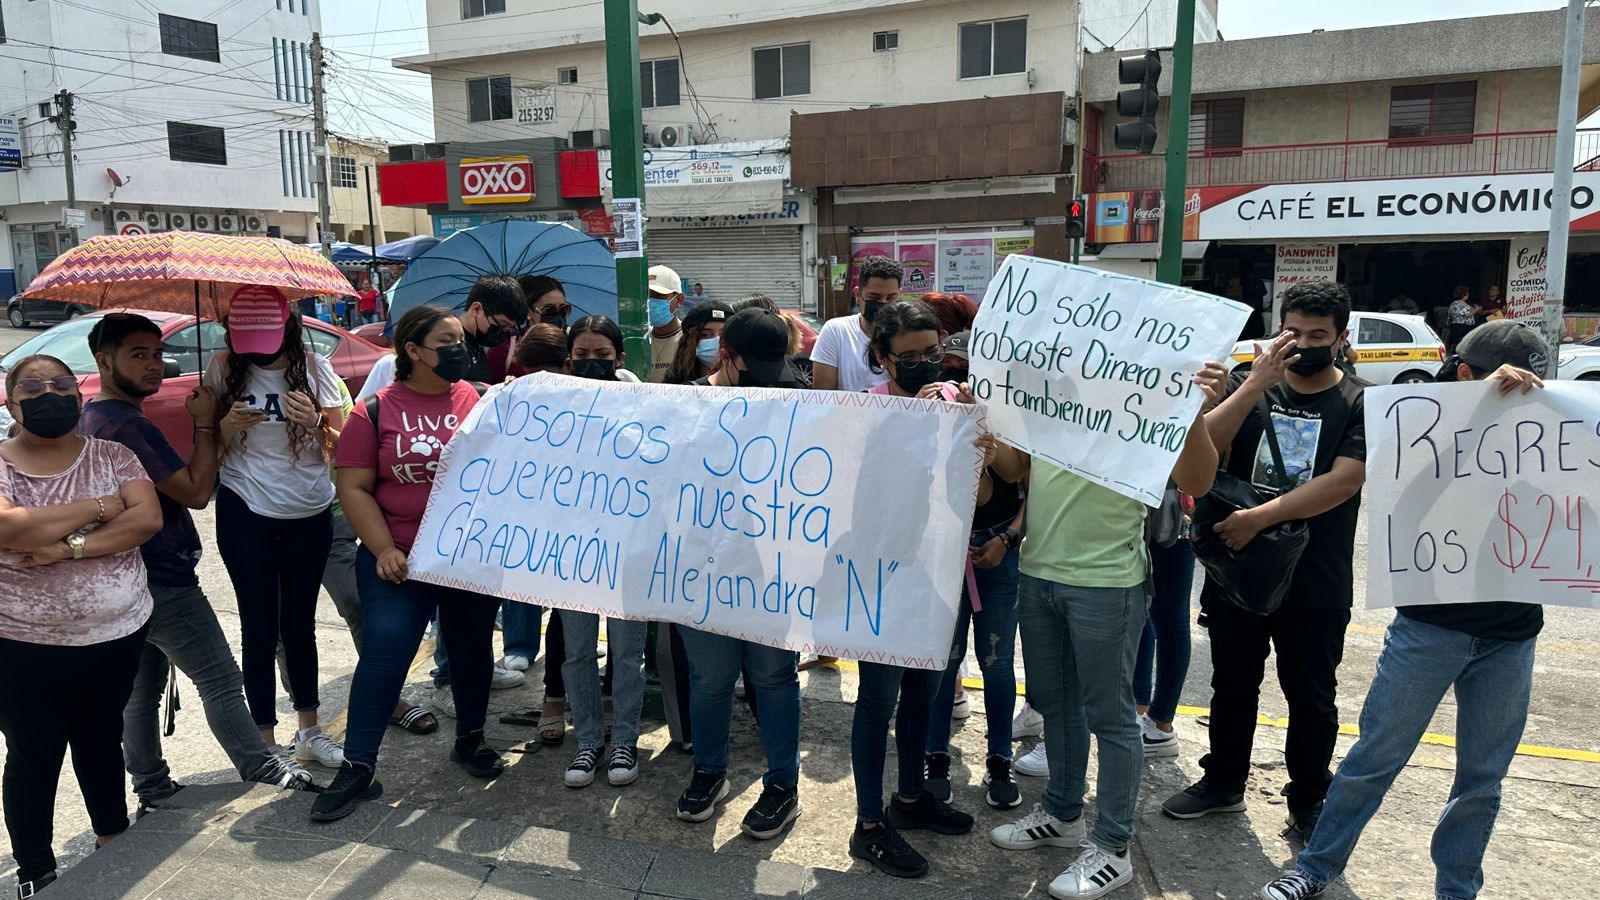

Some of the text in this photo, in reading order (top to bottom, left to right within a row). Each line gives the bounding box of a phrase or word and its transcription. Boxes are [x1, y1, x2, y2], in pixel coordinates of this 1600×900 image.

[518, 106, 554, 122] 215 32 97
[463, 163, 527, 195] OXXO
[1237, 192, 1315, 221] CAFÉ
[1326, 196, 1365, 219] EL
[1277, 245, 1336, 258] SANDWICH
[990, 265, 1038, 316] No
[1134, 315, 1195, 352] nos
[971, 321, 1073, 374] robaste
[1081, 339, 1161, 390] Dinero
[1375, 351, 1393, 359] LIBRE
[402, 411, 459, 432] Live
[475, 385, 833, 497] Nosotros Solo
[1086, 406, 1113, 434] un
[1118, 392, 1187, 453] Sueño
[459, 457, 831, 549] queremos nuestra
[436, 501, 621, 591] GRADUACIÓN
[647, 531, 816, 625] Alejandra
[1387, 513, 1468, 574] LOS
